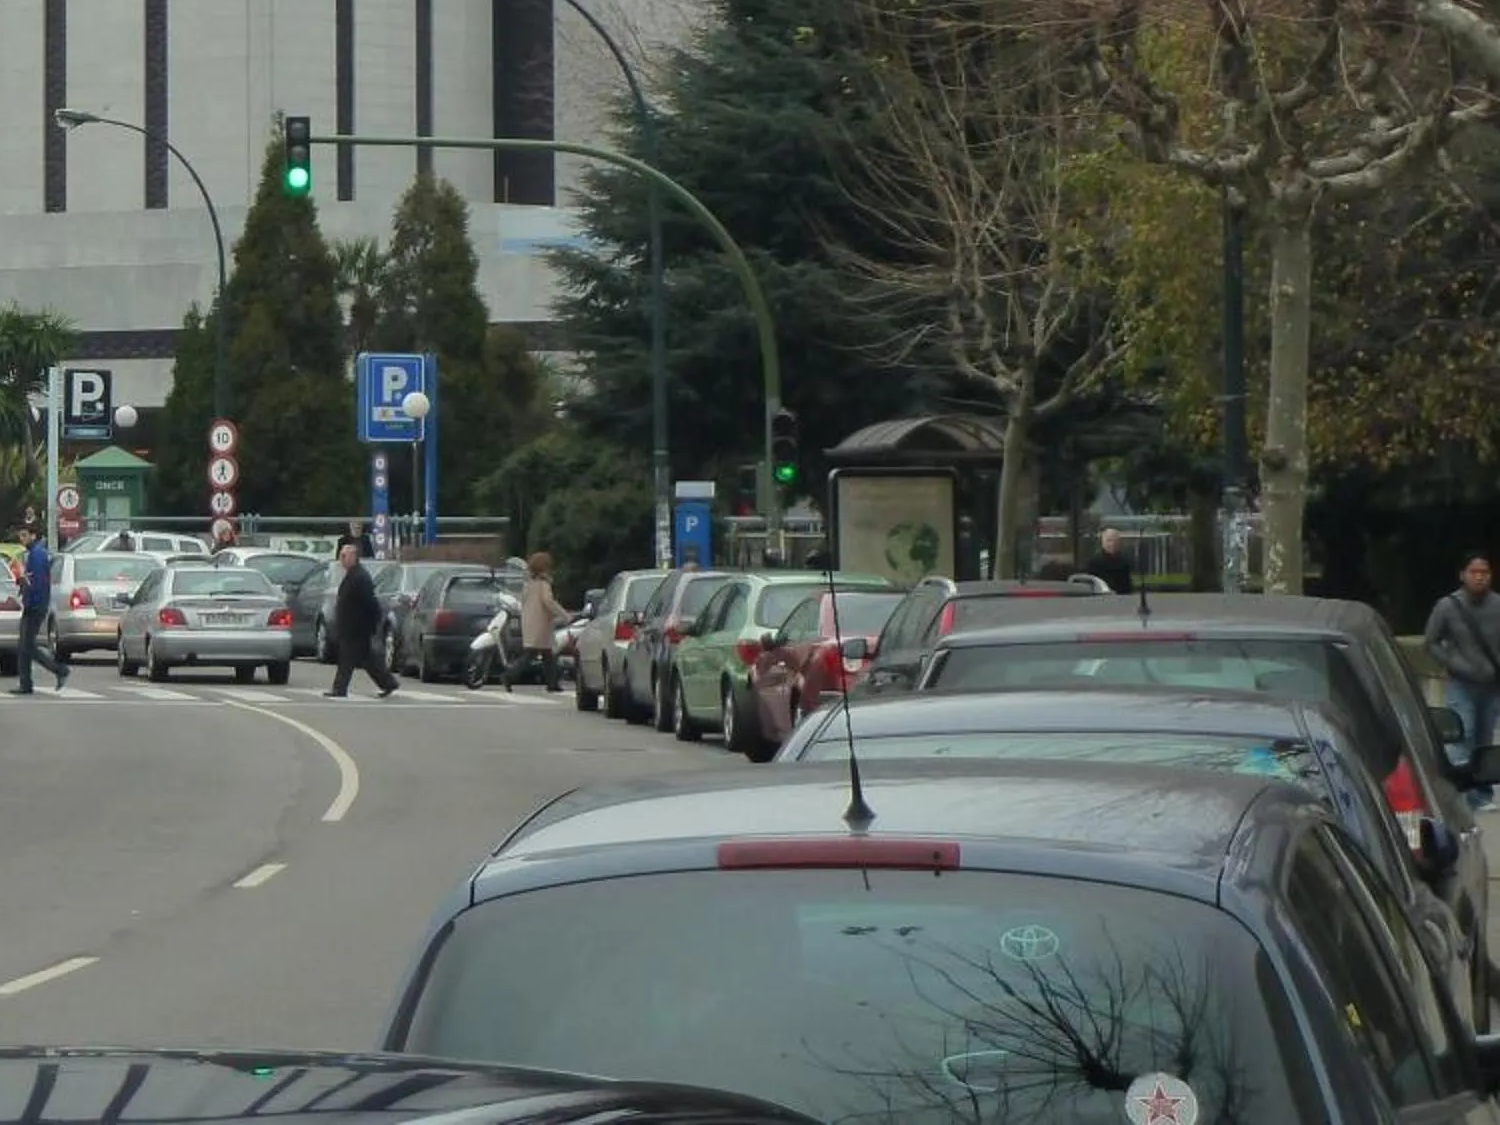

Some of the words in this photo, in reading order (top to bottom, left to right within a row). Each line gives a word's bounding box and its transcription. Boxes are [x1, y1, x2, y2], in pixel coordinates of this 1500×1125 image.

[71, 372, 105, 416] P
[382, 366, 408, 403] P
[685, 515, 699, 533] P
